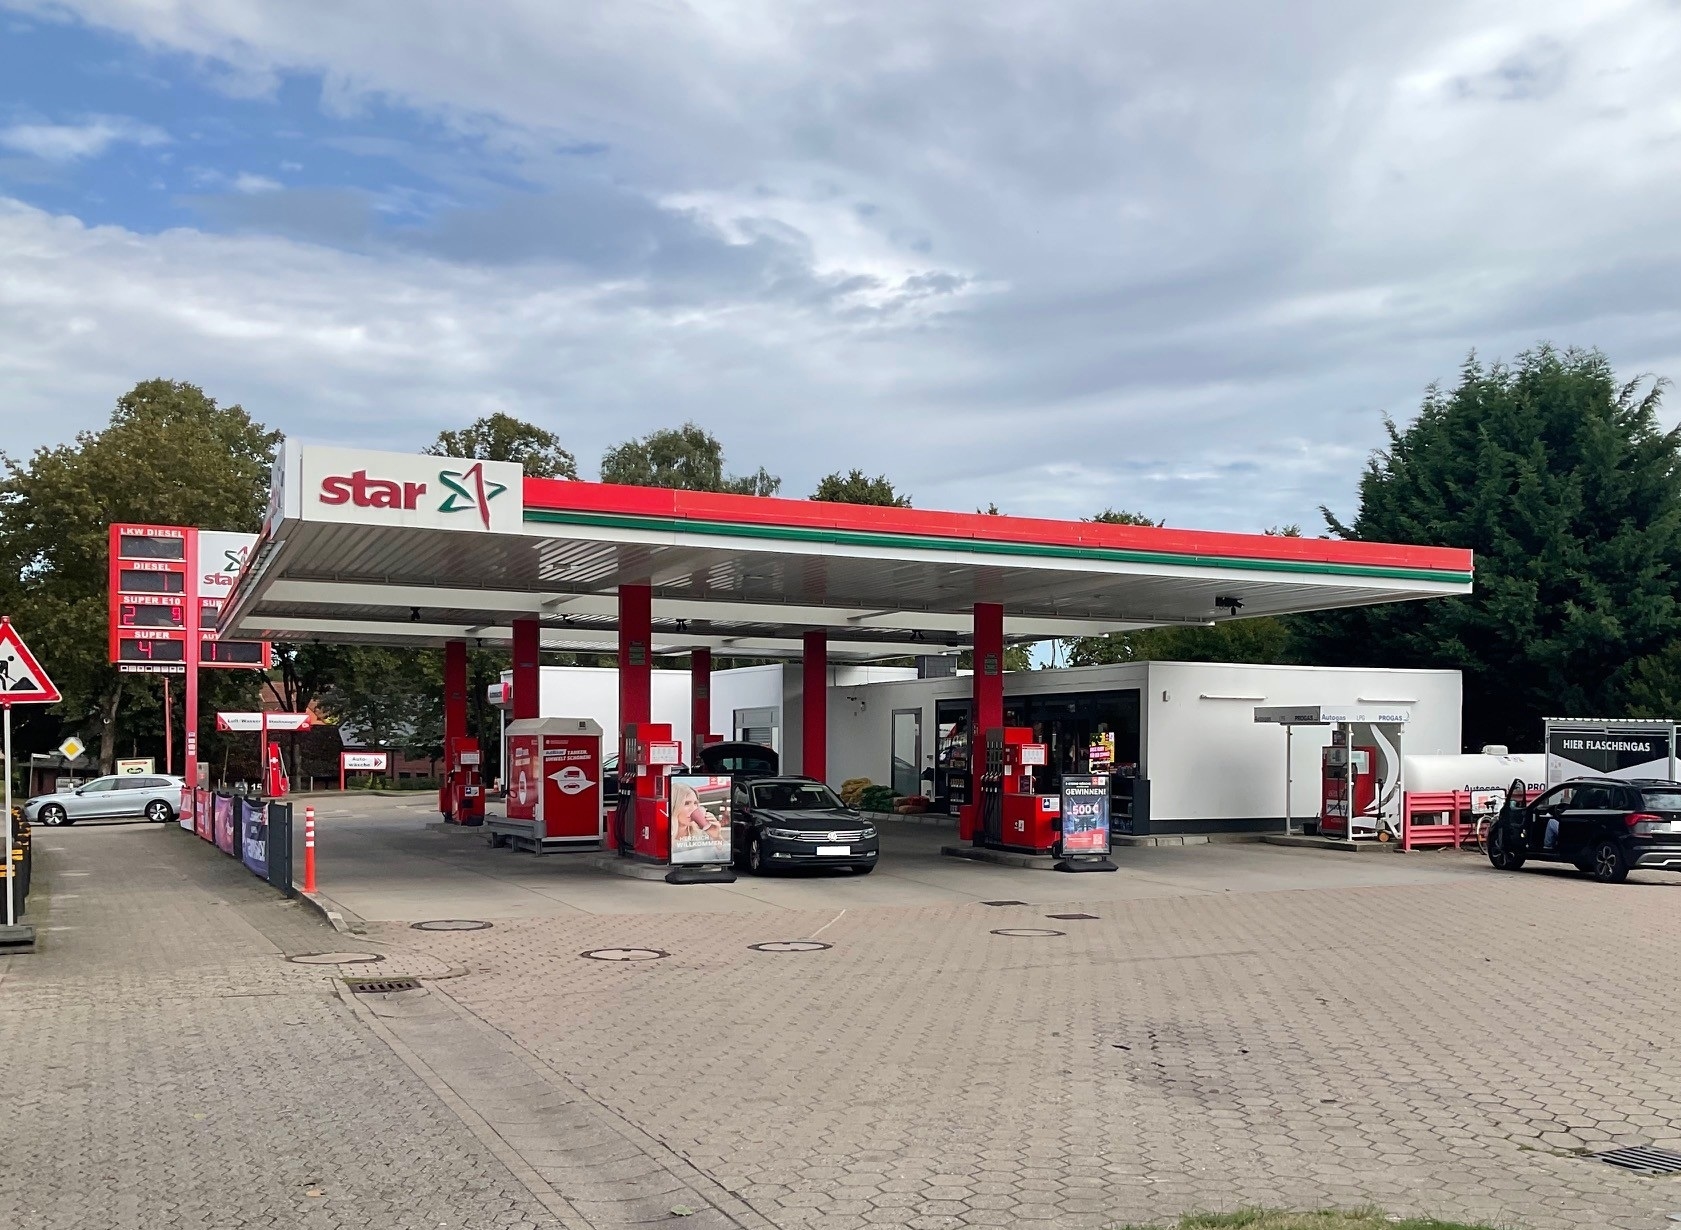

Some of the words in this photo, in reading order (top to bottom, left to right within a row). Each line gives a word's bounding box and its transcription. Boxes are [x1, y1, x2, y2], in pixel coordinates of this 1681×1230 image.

[319, 469, 427, 510] star
[120, 527, 144, 536] LKW
[146, 528, 184, 538] DIESEL
[133, 562, 171, 571] DIESEL
[123, 596, 159, 604] SUPER
[162, 597, 181, 605] E10
[134, 631, 170, 639] SUPER
[1321, 714, 1346, 722] Autogas
[1563, 739, 1584, 750] HIER
[1586, 740, 1651, 752] FLASCHENGAS
[1065, 788, 1107, 796] GEWINNEN!
